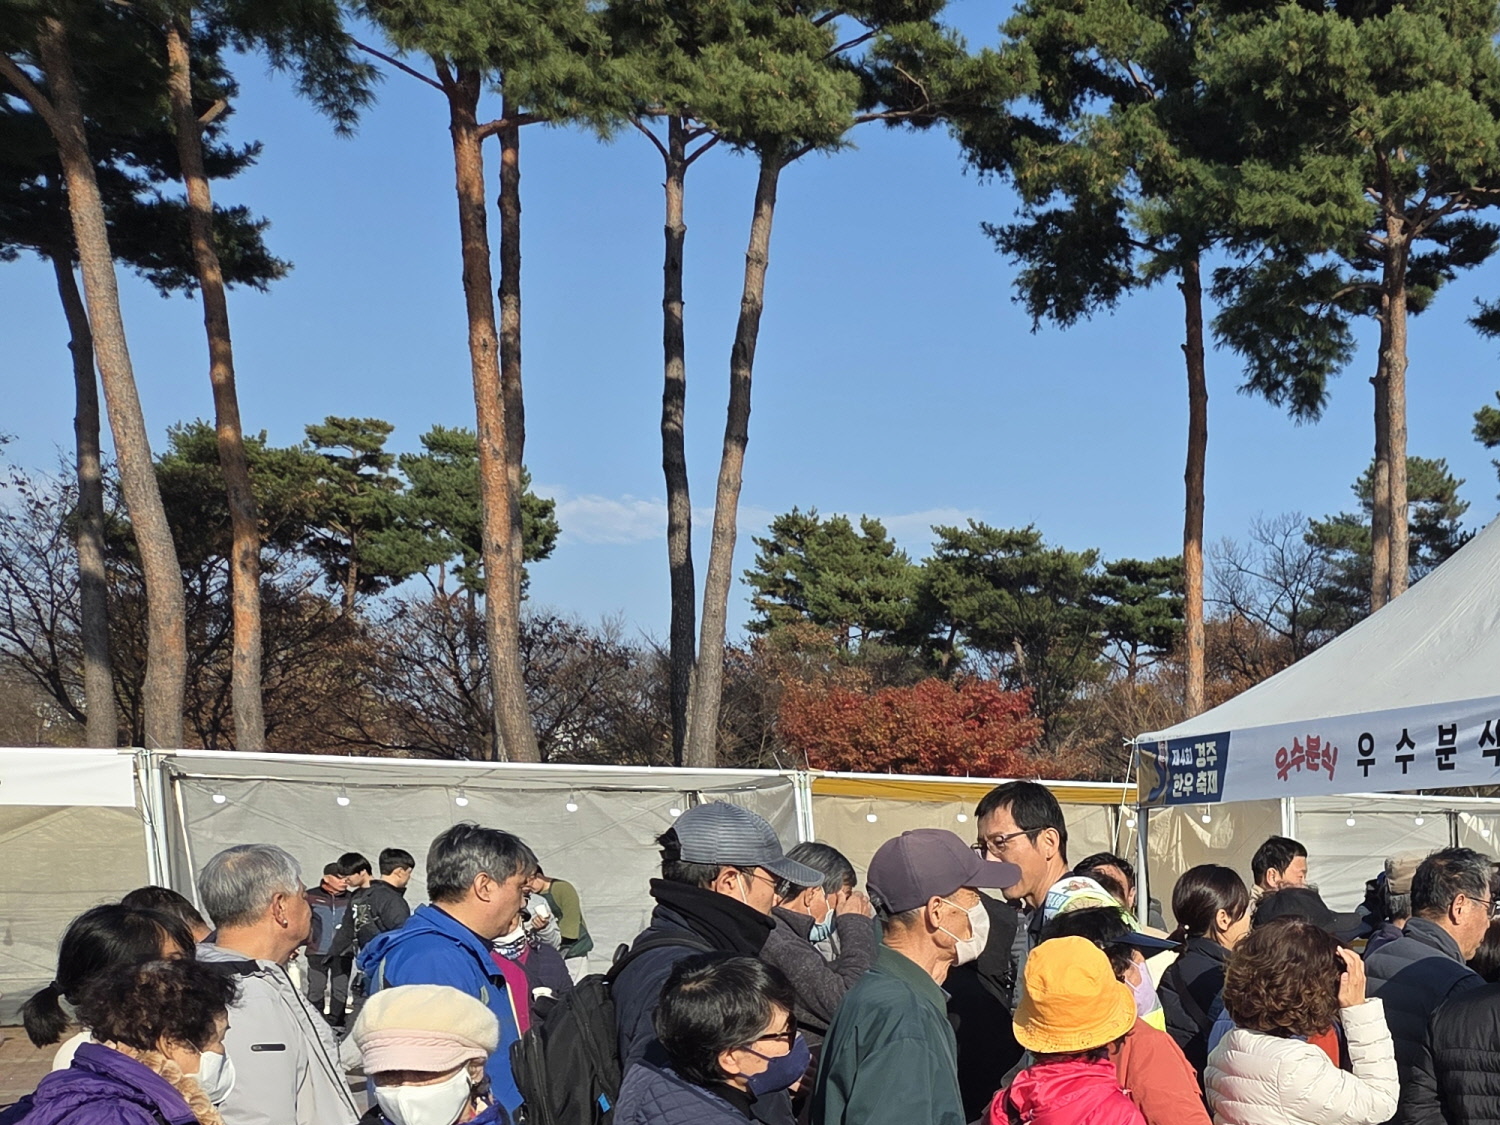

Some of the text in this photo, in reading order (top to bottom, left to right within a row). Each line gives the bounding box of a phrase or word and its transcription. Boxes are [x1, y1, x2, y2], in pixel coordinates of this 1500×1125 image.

[1172, 741, 1217, 768] 제4회 경주
[1275, 734, 1338, 781] 우수분식
[1172, 770, 1218, 797] 한우 축제
